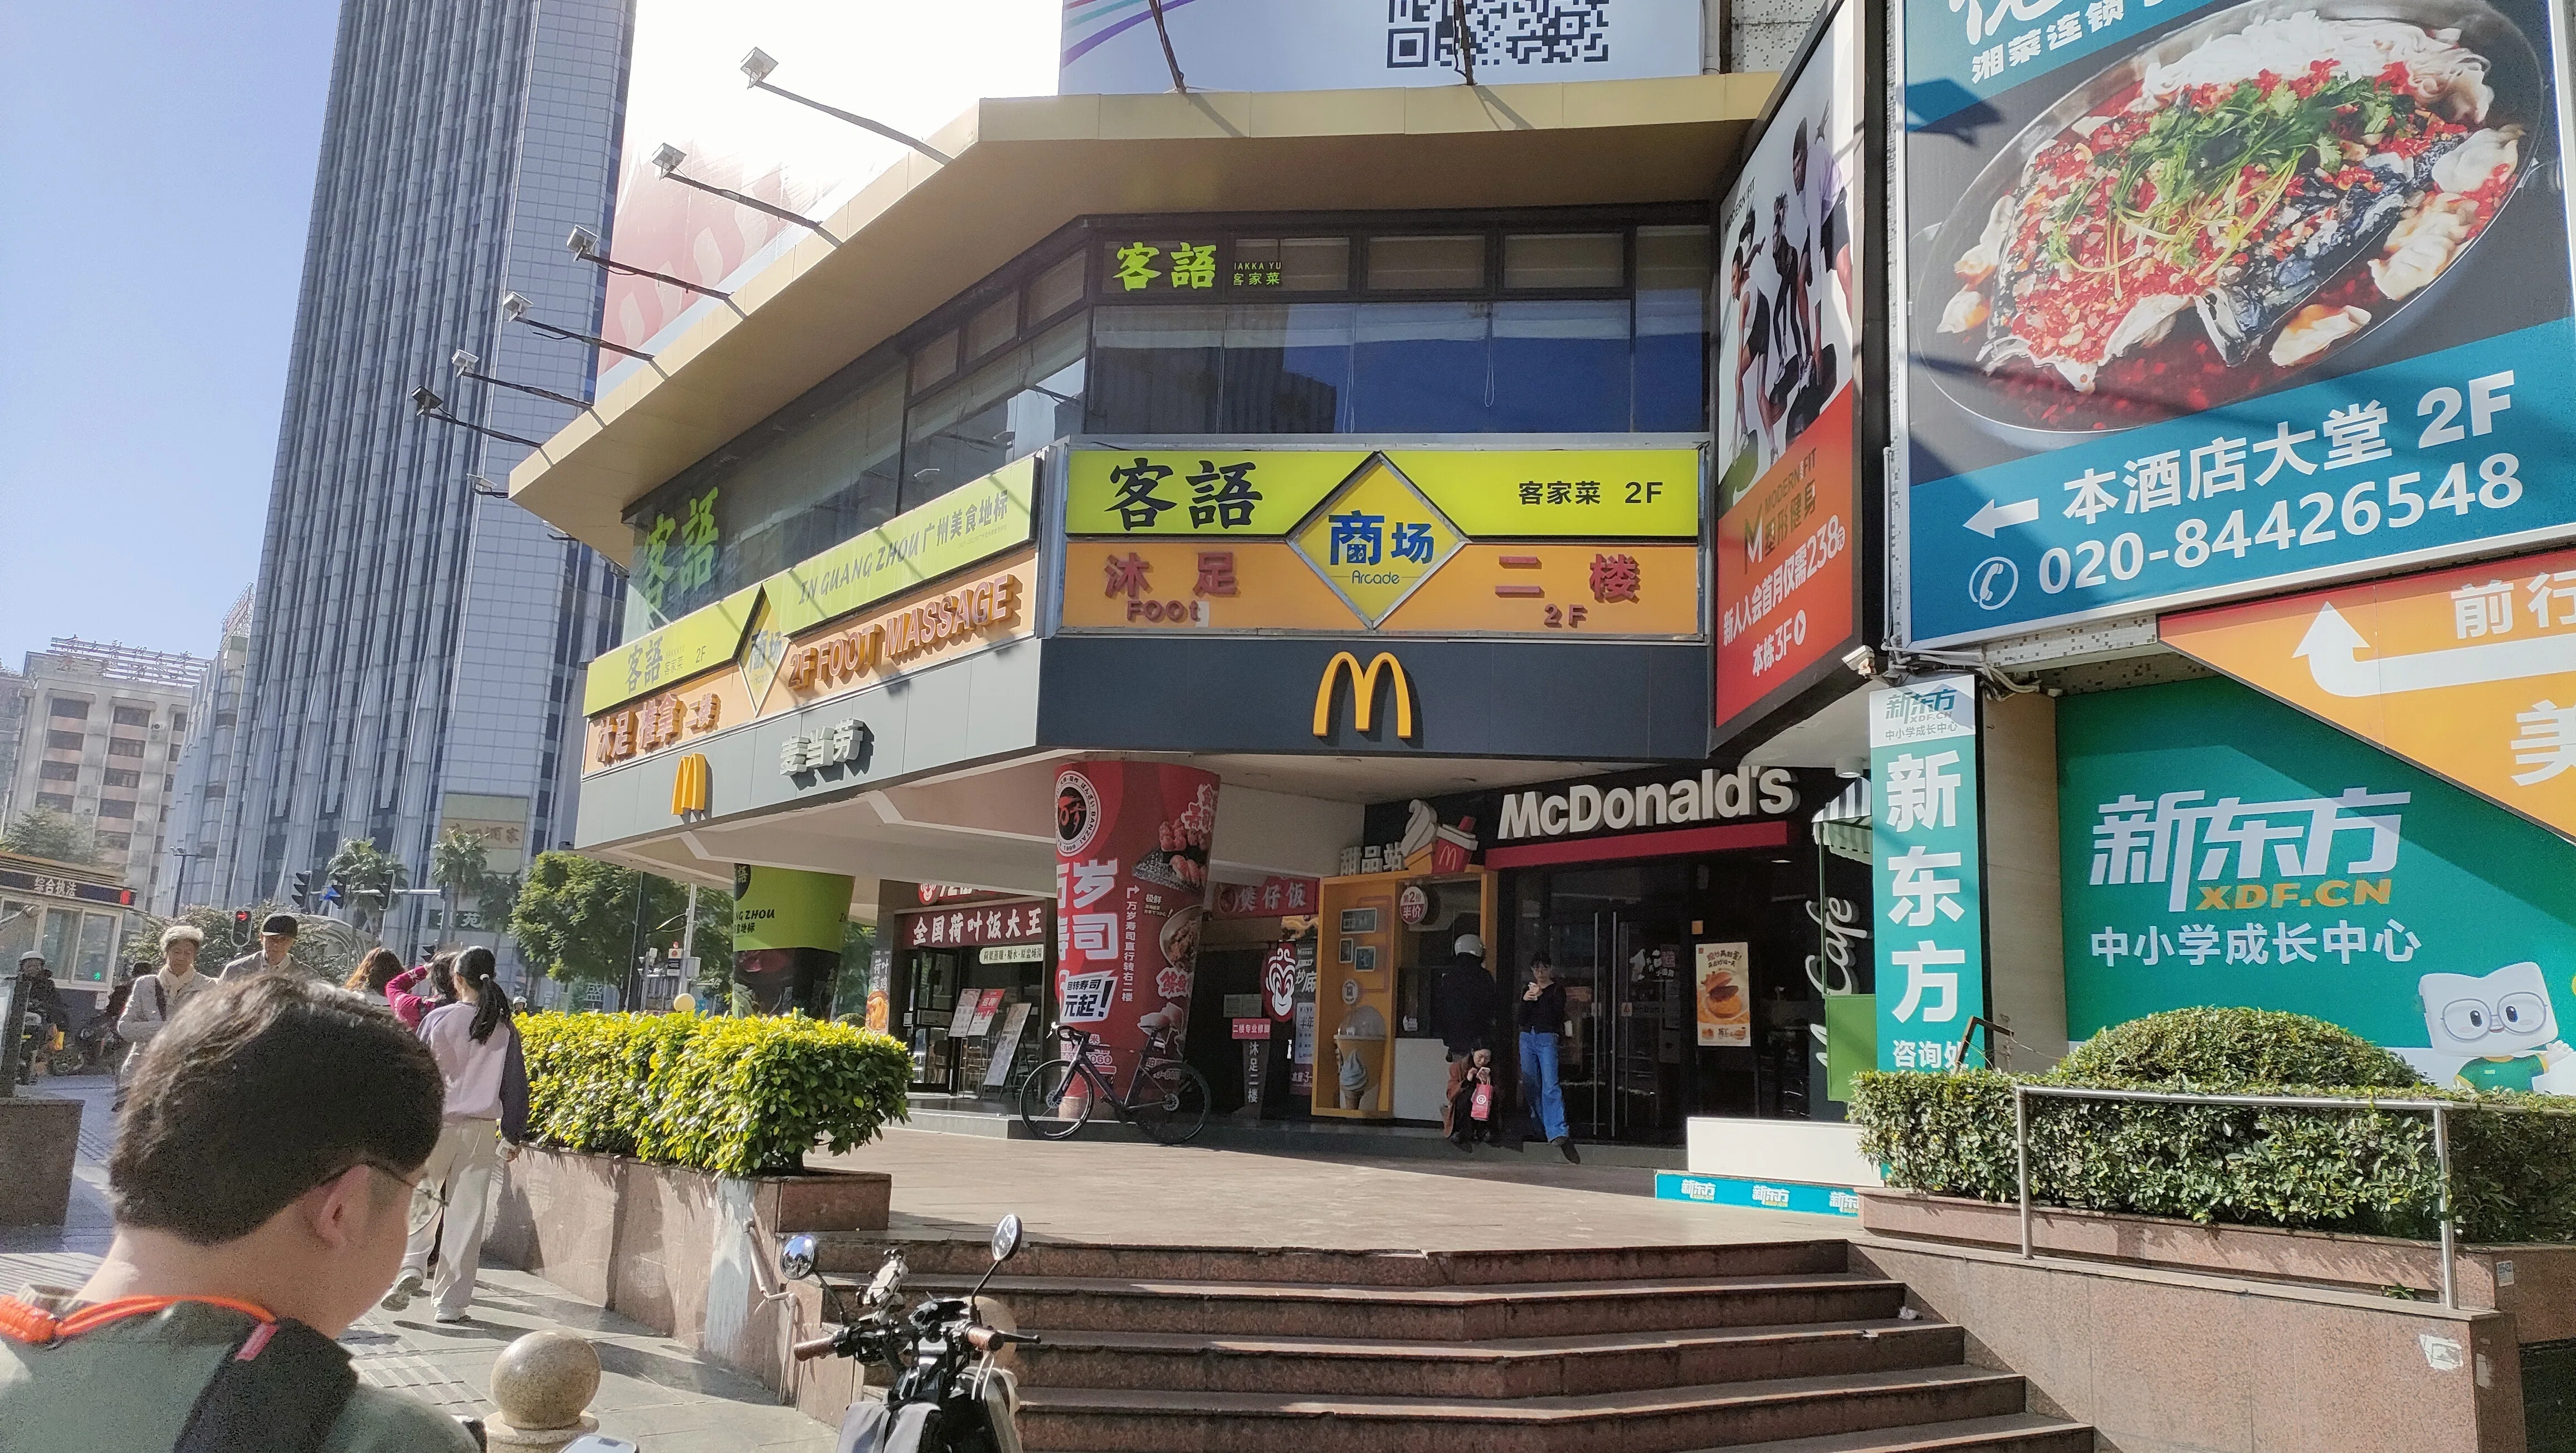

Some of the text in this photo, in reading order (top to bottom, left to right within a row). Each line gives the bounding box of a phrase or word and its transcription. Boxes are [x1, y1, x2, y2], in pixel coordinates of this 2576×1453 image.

[1972, 0, 2124, 84] 湘菜连锁
[1113, 242, 1217, 291] 客語
[1233, 272, 1281, 286] 客家菜
[2062, 369, 2516, 525] 本酒店大堂 2F
[1104, 458, 1662, 530] 客語 客家菜 2F
[1764, 467, 1801, 516] MODERN
[1803, 447, 1817, 478] FIT
[1328, 509, 1434, 566] 商场
[1764, 478, 1816, 557] 塑形健身
[2038, 452, 2524, 594] 020-84426548
[798, 489, 1008, 605] IN GUANG ZHOU 广州美食地标
[1105, 551, 1641, 601] 沐足 二楼
[1352, 569, 1399, 585] Arcade
[788, 574, 1009, 689] 2F FOOT MASSAGE
[1544, 604, 1588, 625] 2F
[625, 636, 663, 694] 客語
[695, 645, 706, 664] 2F
[1752, 617, 1792, 677] 本栋3F
[1886, 689, 1957, 724] 新东方
[1910, 711, 1953, 724] XDF.CN
[780, 718, 863, 776] 麦当劳
[1886, 721, 1958, 740] 中小学成长中心
[1497, 766, 1797, 840] McDonald's
[1080, 811, 1096, 844] BANZAI
[1340, 841, 1404, 876] 甜品站
[2090, 788, 2412, 911] 新东方
[34, 876, 77, 896] 综合执法
[1403, 891, 1421, 903] 第2份
[1886, 750, 1965, 1024] 新东方
[2196, 879, 2392, 910] XDF.CN
[745, 909, 775, 919] ZHOU
[913, 907, 1042, 946] 全国荷叶饭大王
[1403, 905, 1421, 919] 半价
[1121, 901, 1138, 1002] 万岁寿司直行转右二楼
[2091, 920, 2422, 968] 中小学成长中心
[874, 958, 889, 974] 荷叶
[1067, 979, 1101, 991] 回转寿司
[1232, 1023, 1270, 1034] 二楼专业修脚
[1247, 1041, 1259, 1103] 沐足二楼
[1681, 1178, 1716, 1199] 新东方
[1753, 1184, 1789, 1205] 新东方
